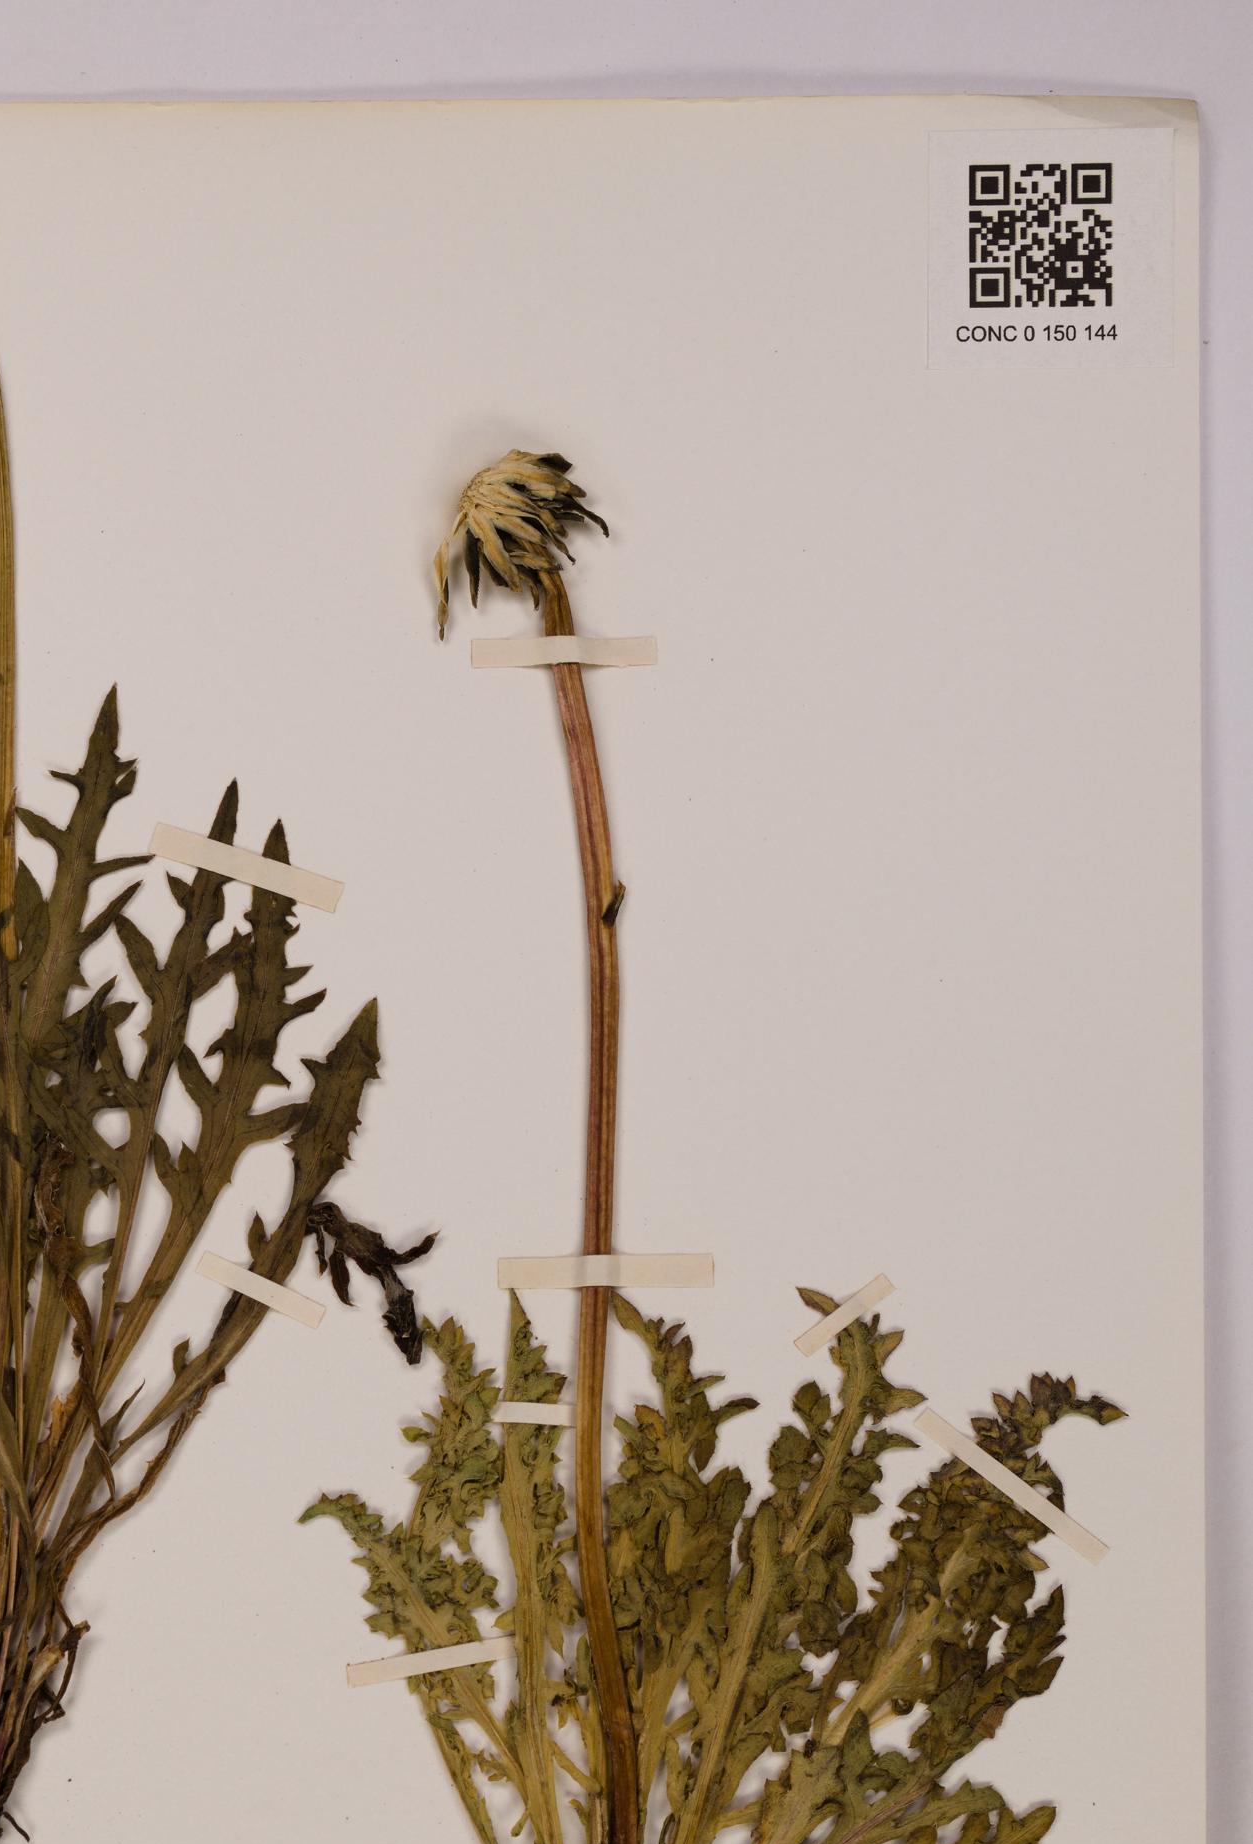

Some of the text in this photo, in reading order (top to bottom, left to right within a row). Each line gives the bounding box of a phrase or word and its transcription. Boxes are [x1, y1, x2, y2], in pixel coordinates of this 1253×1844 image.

[956, 324, 1118, 343] CONC 0 150 144
